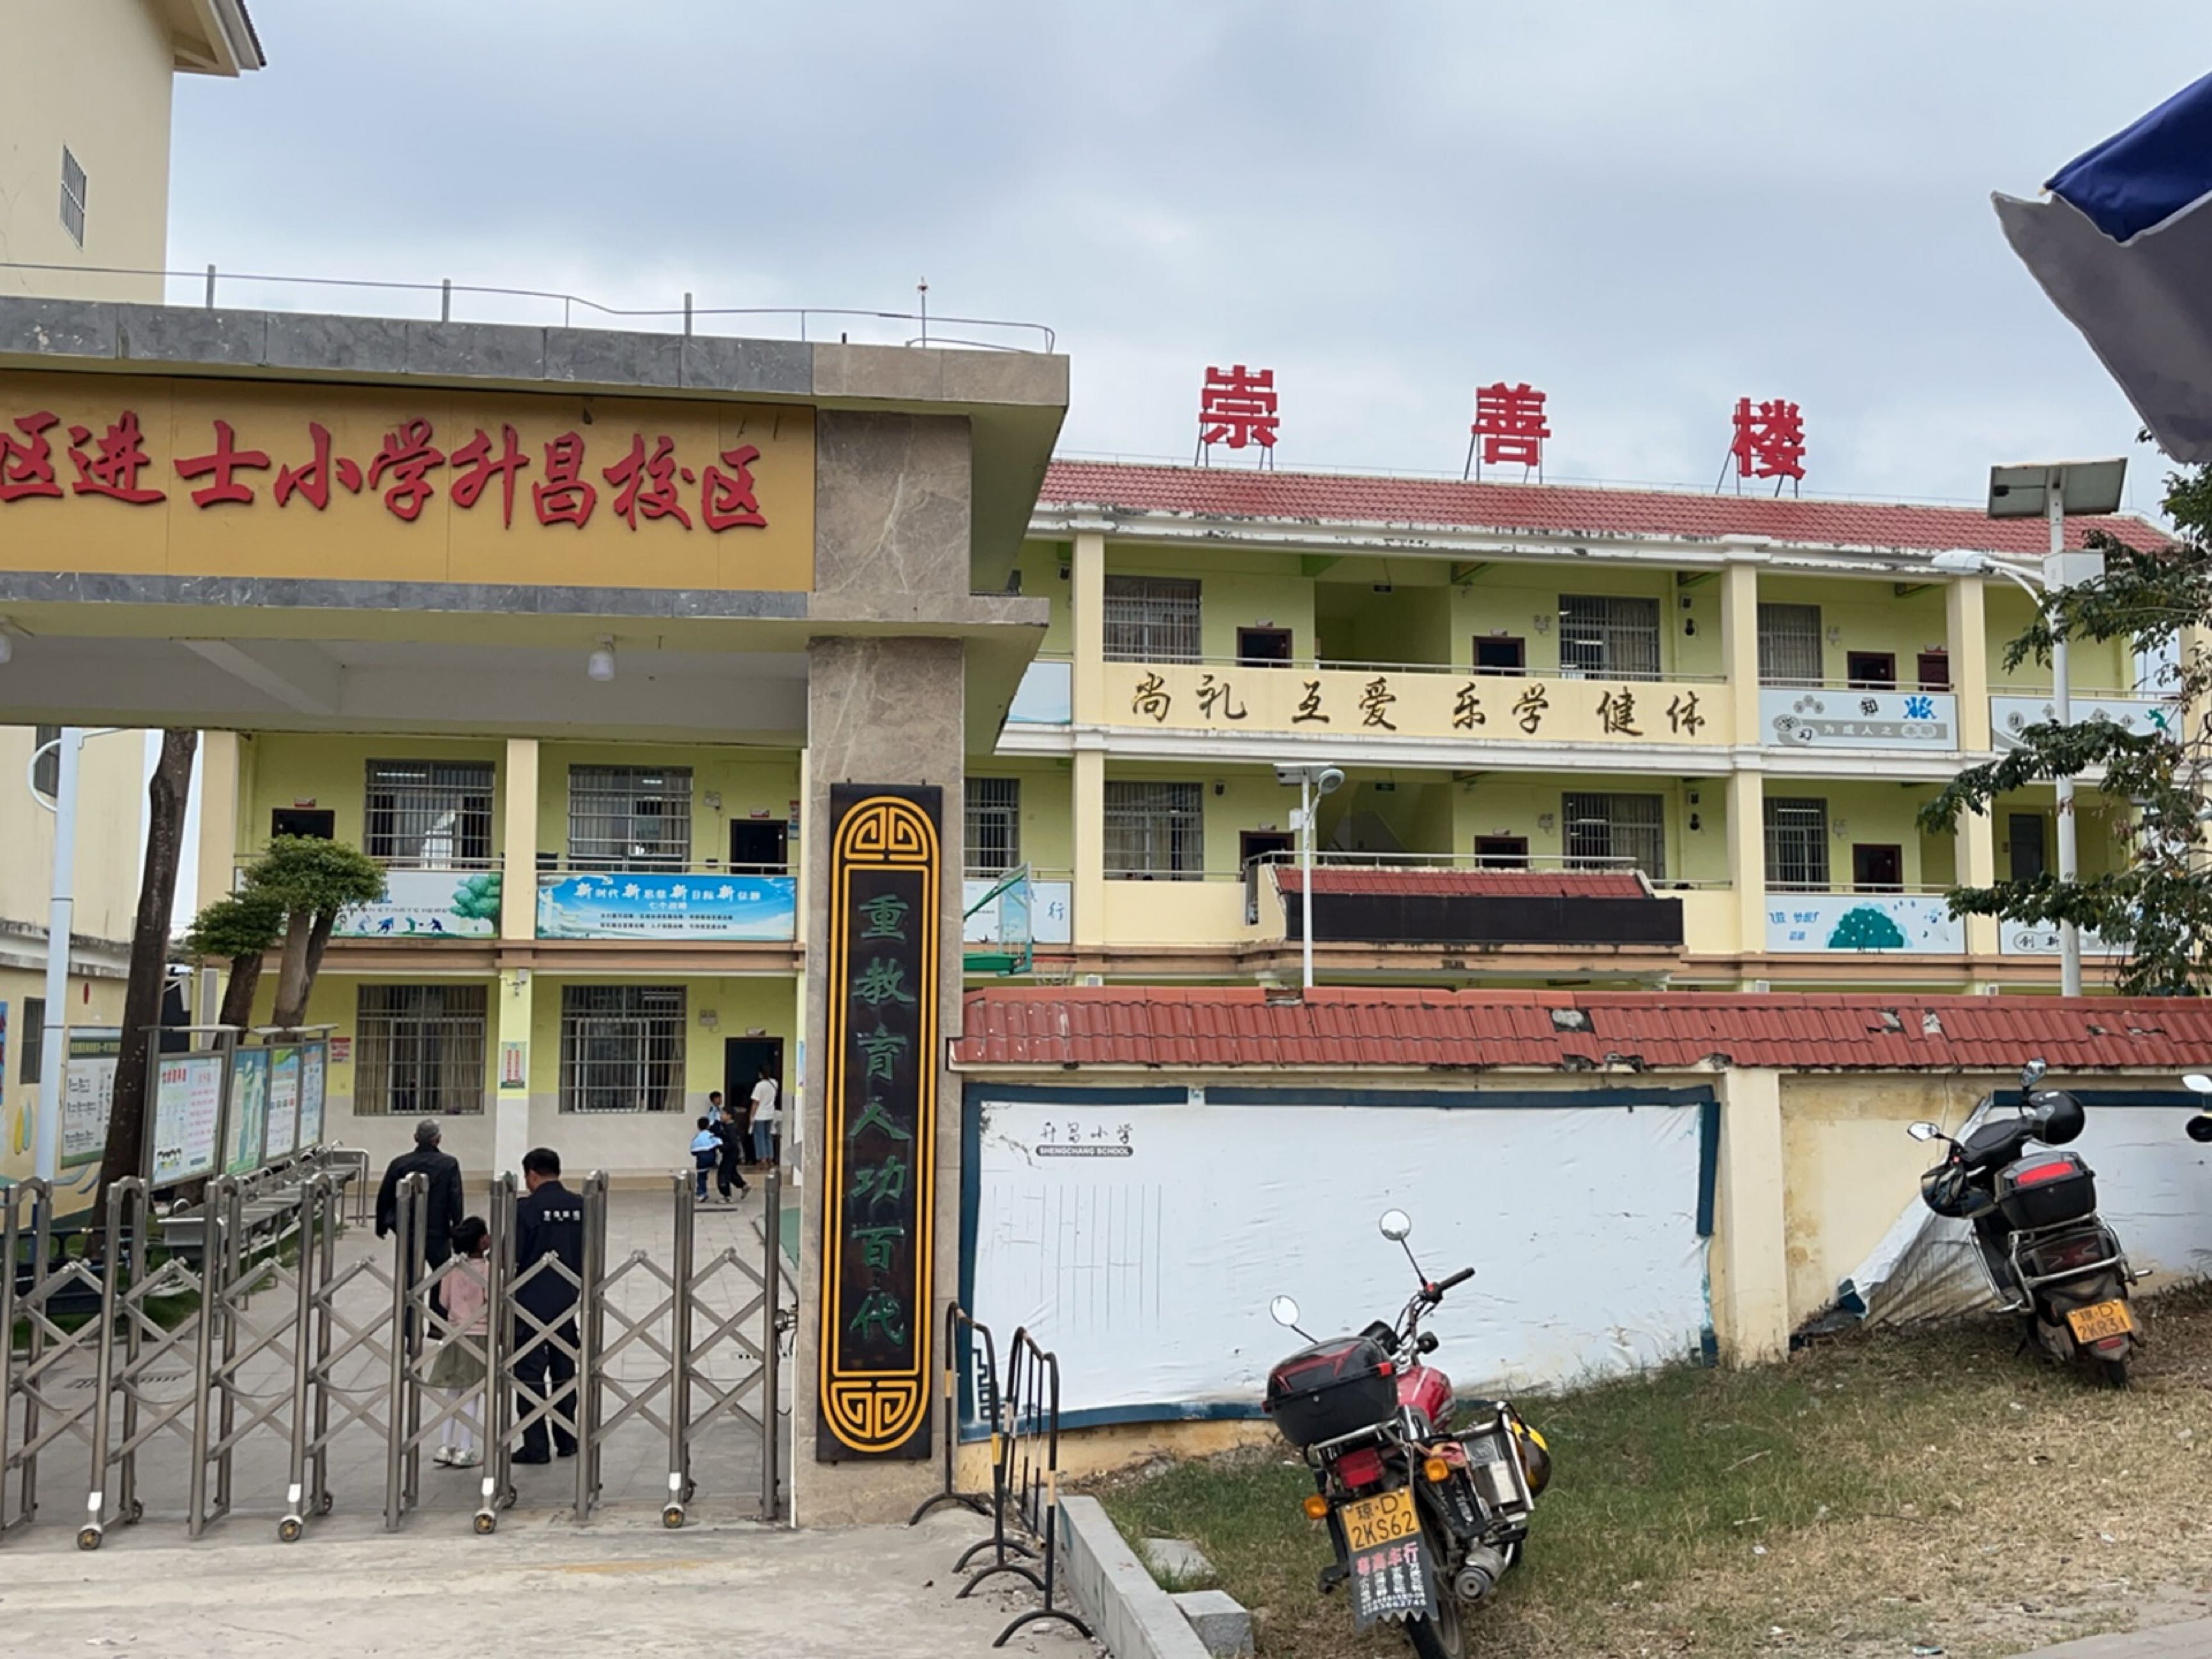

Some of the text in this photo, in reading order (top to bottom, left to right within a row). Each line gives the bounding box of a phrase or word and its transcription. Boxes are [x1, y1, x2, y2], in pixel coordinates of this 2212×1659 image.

[1199, 365, 1806, 480] 崇善楼
[1131, 671, 1706, 737] 尚礼 互爱 乐学 健体
[848, 892, 916, 1348] 重教育人功百代
[1350, 1510, 1416, 1549] 2KS62
